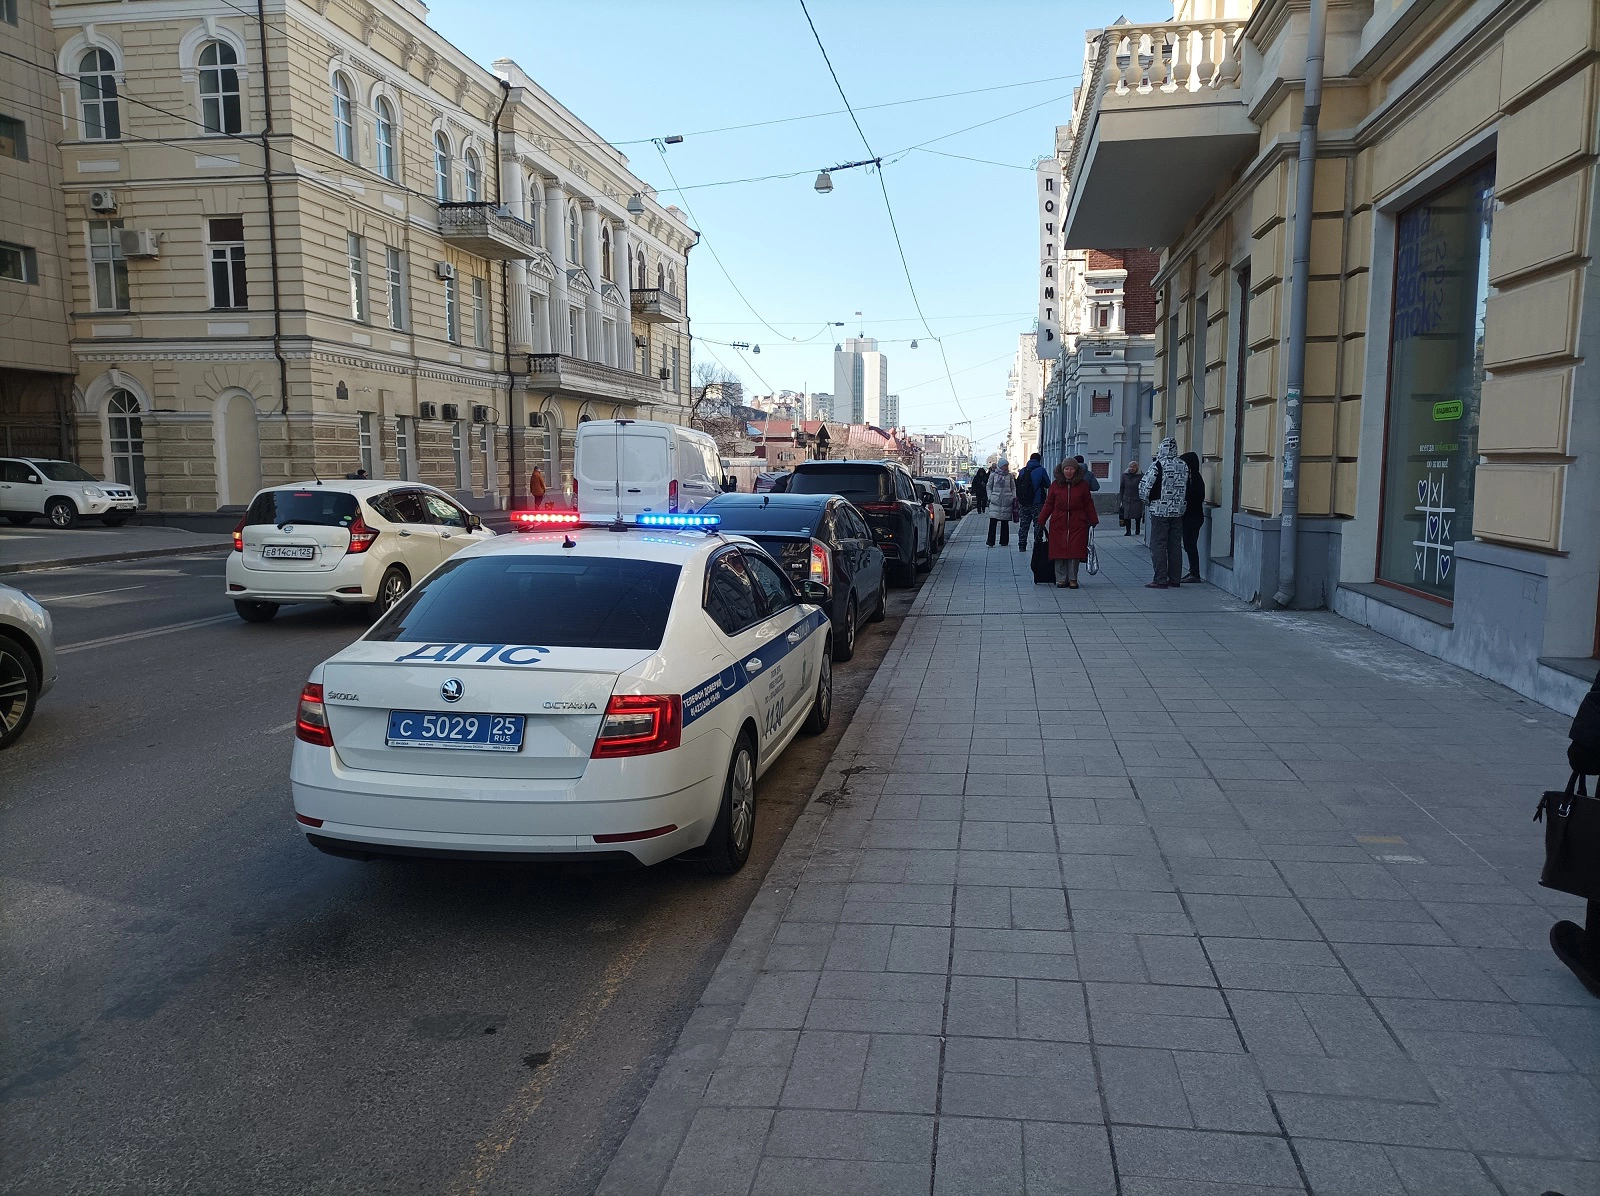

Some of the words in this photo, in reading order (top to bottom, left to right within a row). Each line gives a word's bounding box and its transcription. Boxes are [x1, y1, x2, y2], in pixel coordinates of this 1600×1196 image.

[1044, 178, 1054, 342] ПОЧТАМТЪ
[394, 643, 550, 665] ДПС
[328, 691, 359, 702] ŠKODA
[683, 689, 705, 708] ТЕЛЕФОН
[704, 679, 722, 698] ДОВЕРИЯ
[542, 701, 598, 710] OCTAVIA
[400, 719, 413, 737] С
[421, 715, 479, 740] 5029
[492, 717, 516, 735] 25
[493, 734, 511, 742] RUS
